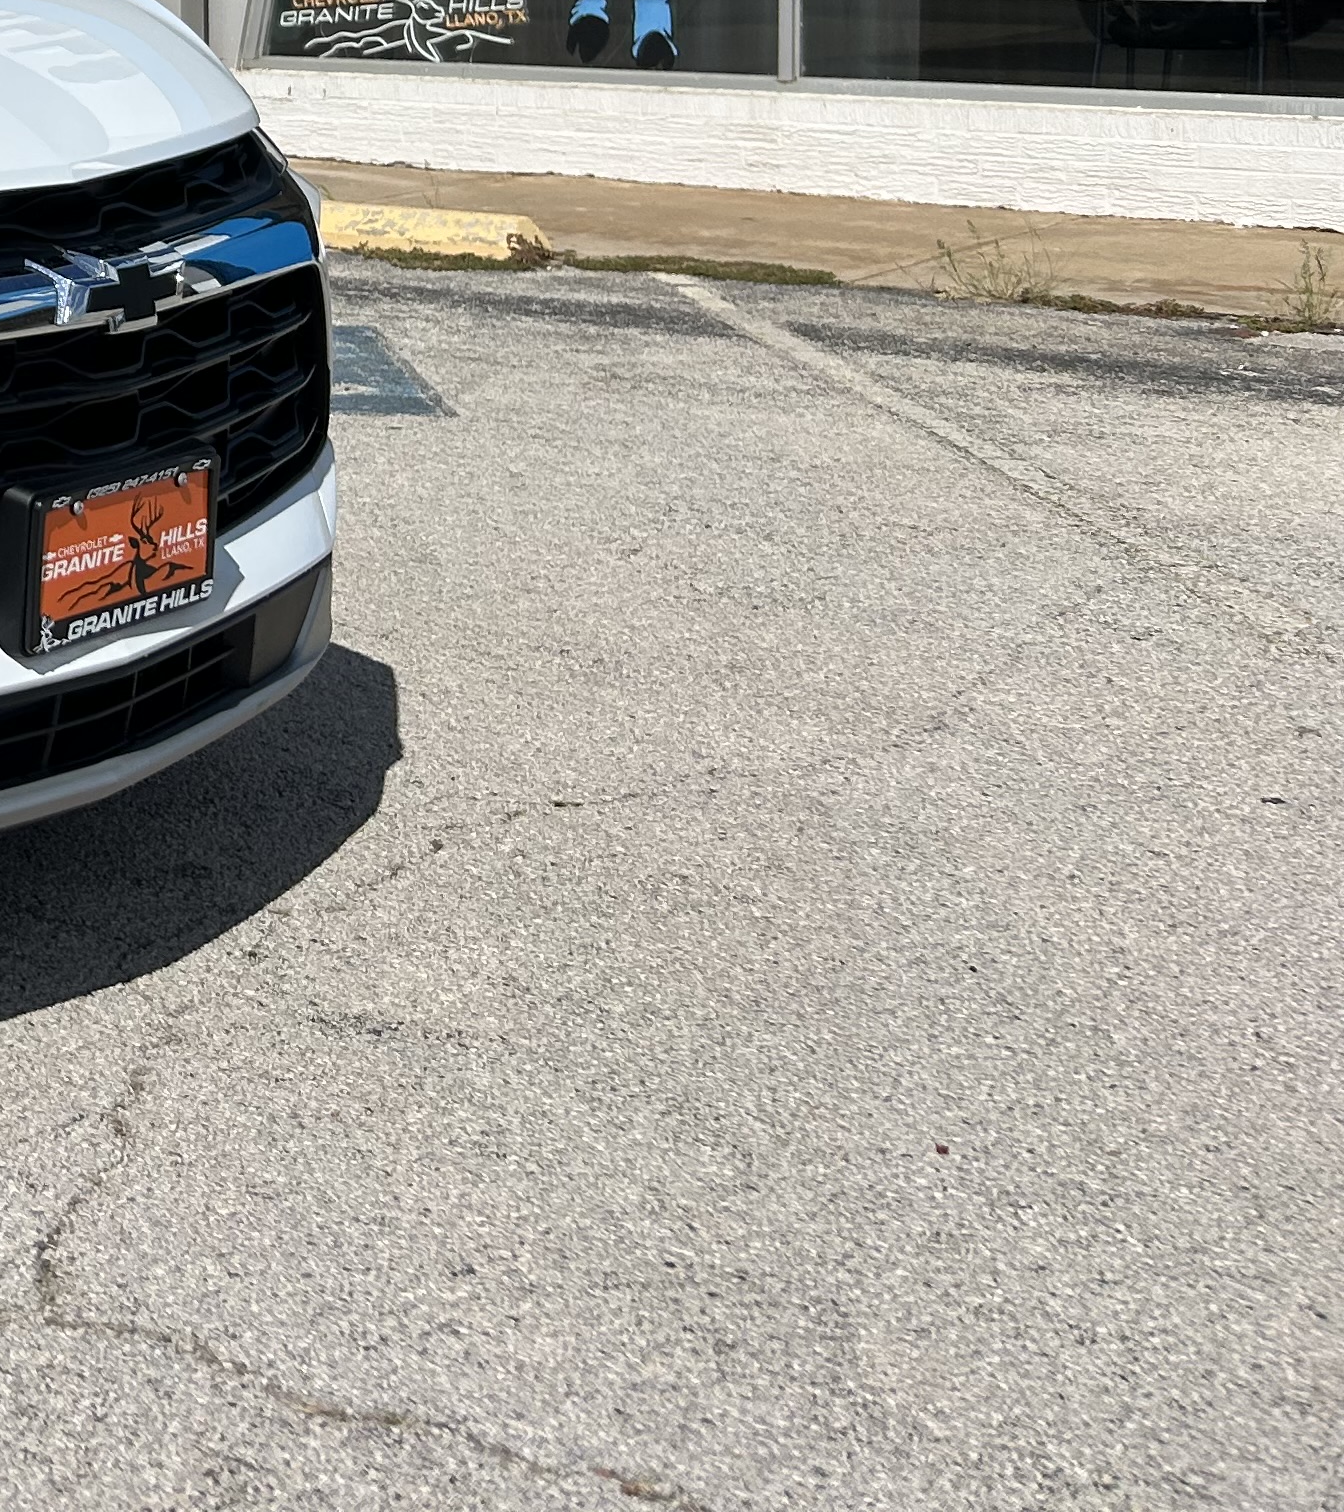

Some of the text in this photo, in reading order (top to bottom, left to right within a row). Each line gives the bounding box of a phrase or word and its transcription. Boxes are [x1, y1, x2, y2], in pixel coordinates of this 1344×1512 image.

[279, 2, 395, 27] GRANITE
[445, 9, 530, 29] LLANO, TX
[41, 518, 208, 582] GRANITE HILLS
[57, 535, 108, 558] CHEVROLET
[194, 538, 205, 550] TX
[68, 579, 214, 640] GRANITE HILLS
